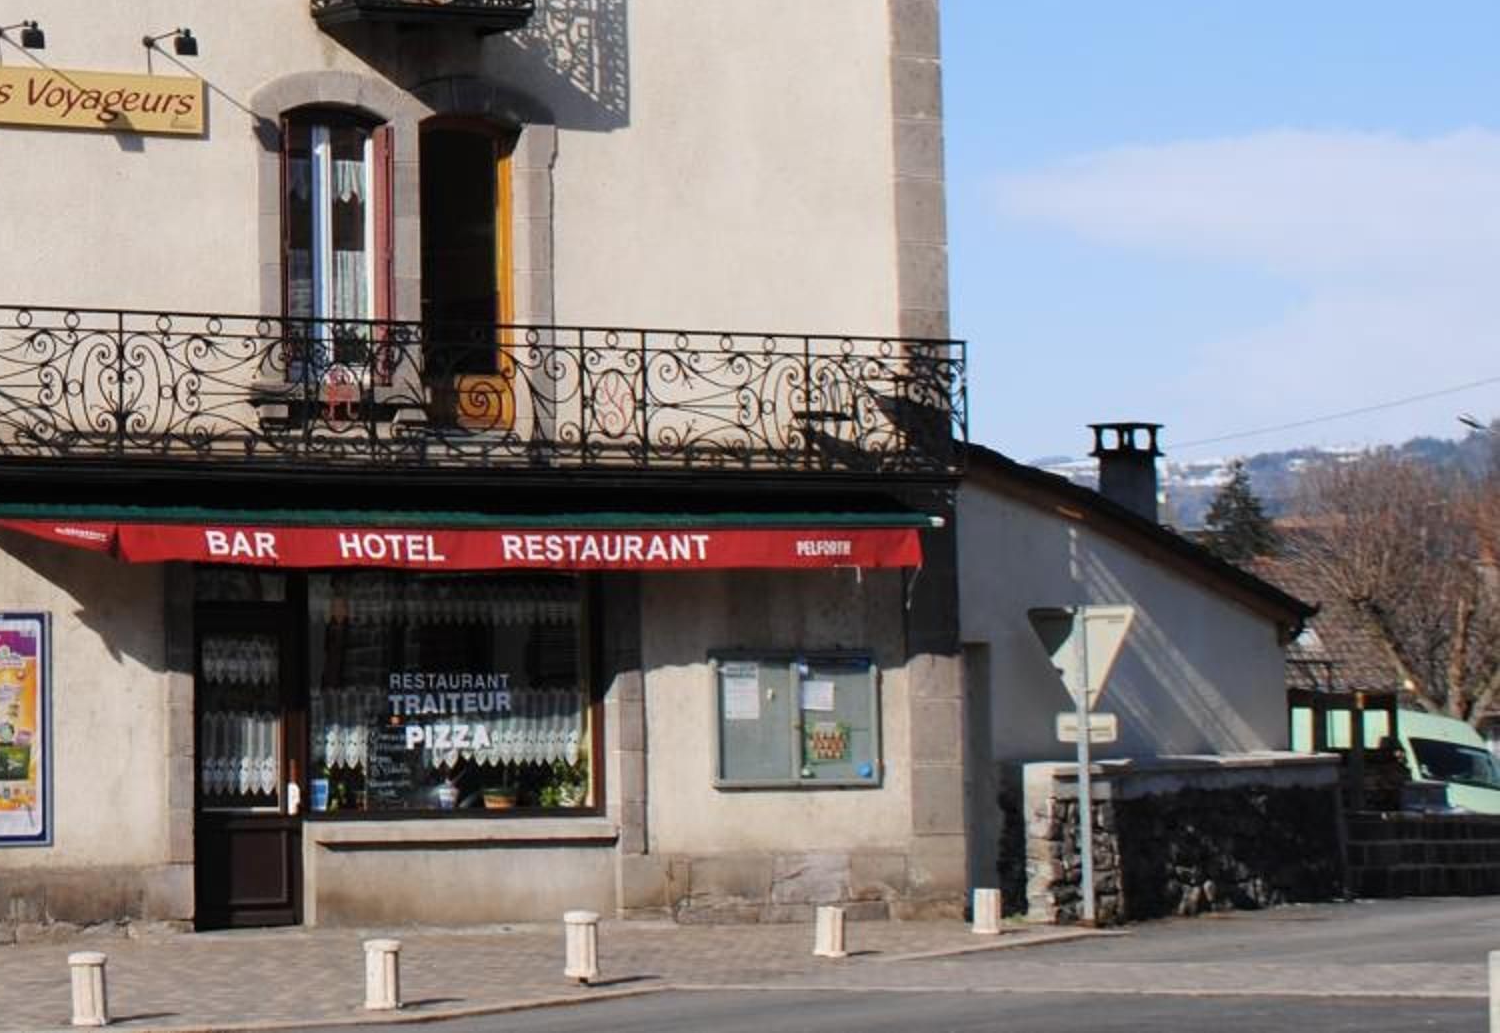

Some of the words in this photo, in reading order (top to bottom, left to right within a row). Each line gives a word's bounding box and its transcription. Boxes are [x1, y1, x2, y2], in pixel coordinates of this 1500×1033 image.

[26, 77, 195, 122] Voyageurs
[205, 530, 278, 558] BAR
[339, 533, 445, 561] HOTEL
[501, 534, 709, 561] RESTAURANT
[796, 540, 852, 556] PELFORTH
[389, 673, 510, 689] RESTAURANT
[388, 692, 511, 715] TRAITEUR
[406, 724, 491, 749] PIZZA
